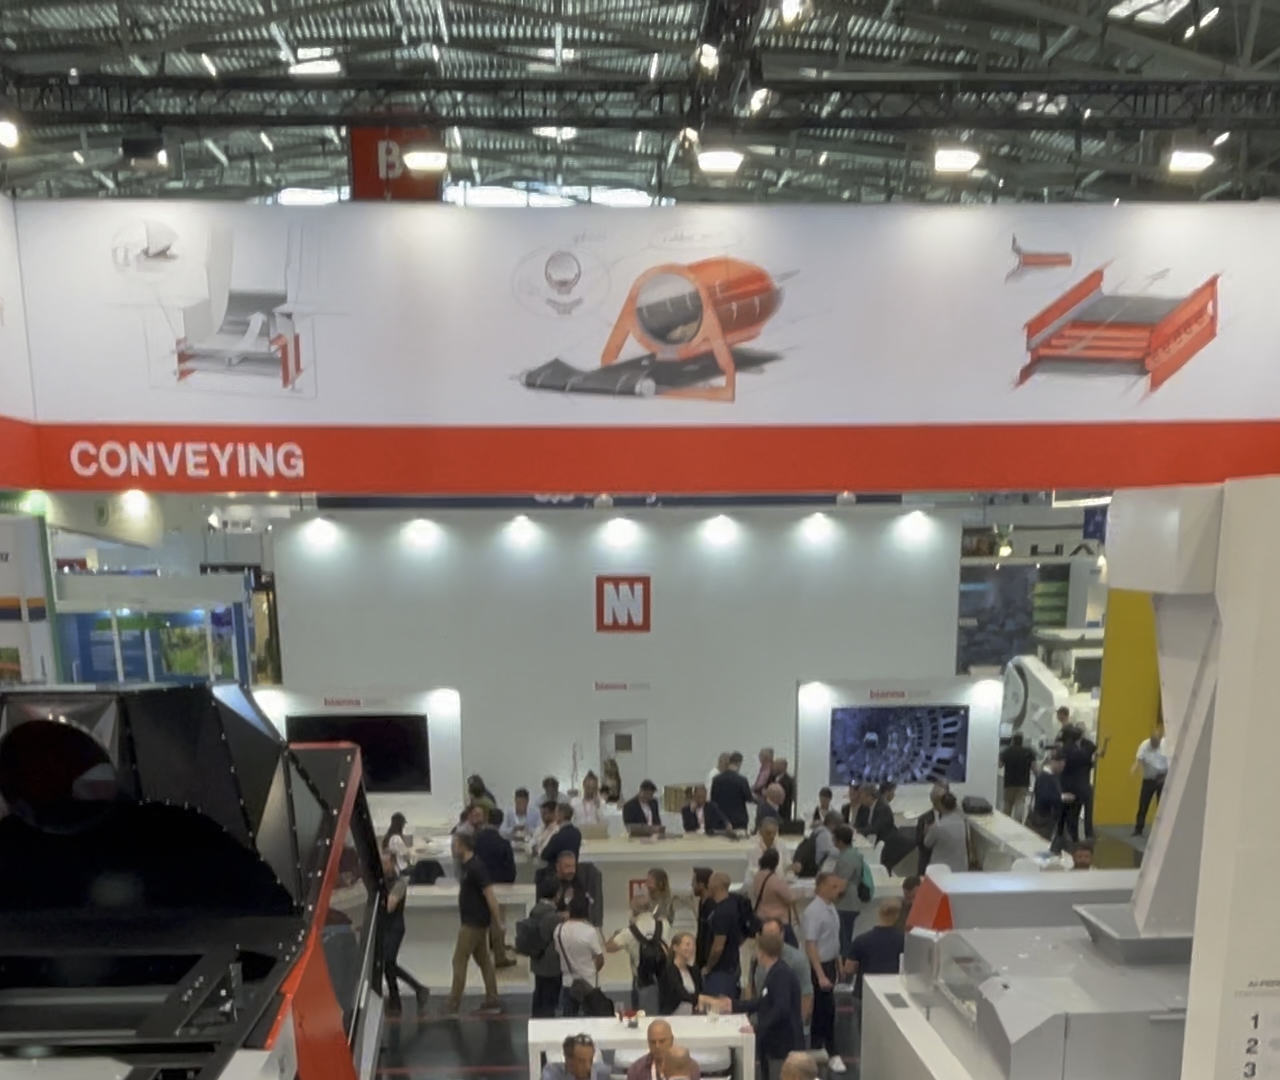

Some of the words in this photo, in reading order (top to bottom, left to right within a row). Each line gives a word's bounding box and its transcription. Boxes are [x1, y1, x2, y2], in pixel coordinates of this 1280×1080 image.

[70, 440, 305, 478] CONVEYING
[1250, 1013, 1260, 1030] 1
[1245, 1037, 1259, 1055] 2
[1243, 1061, 1257, 1079] 3
